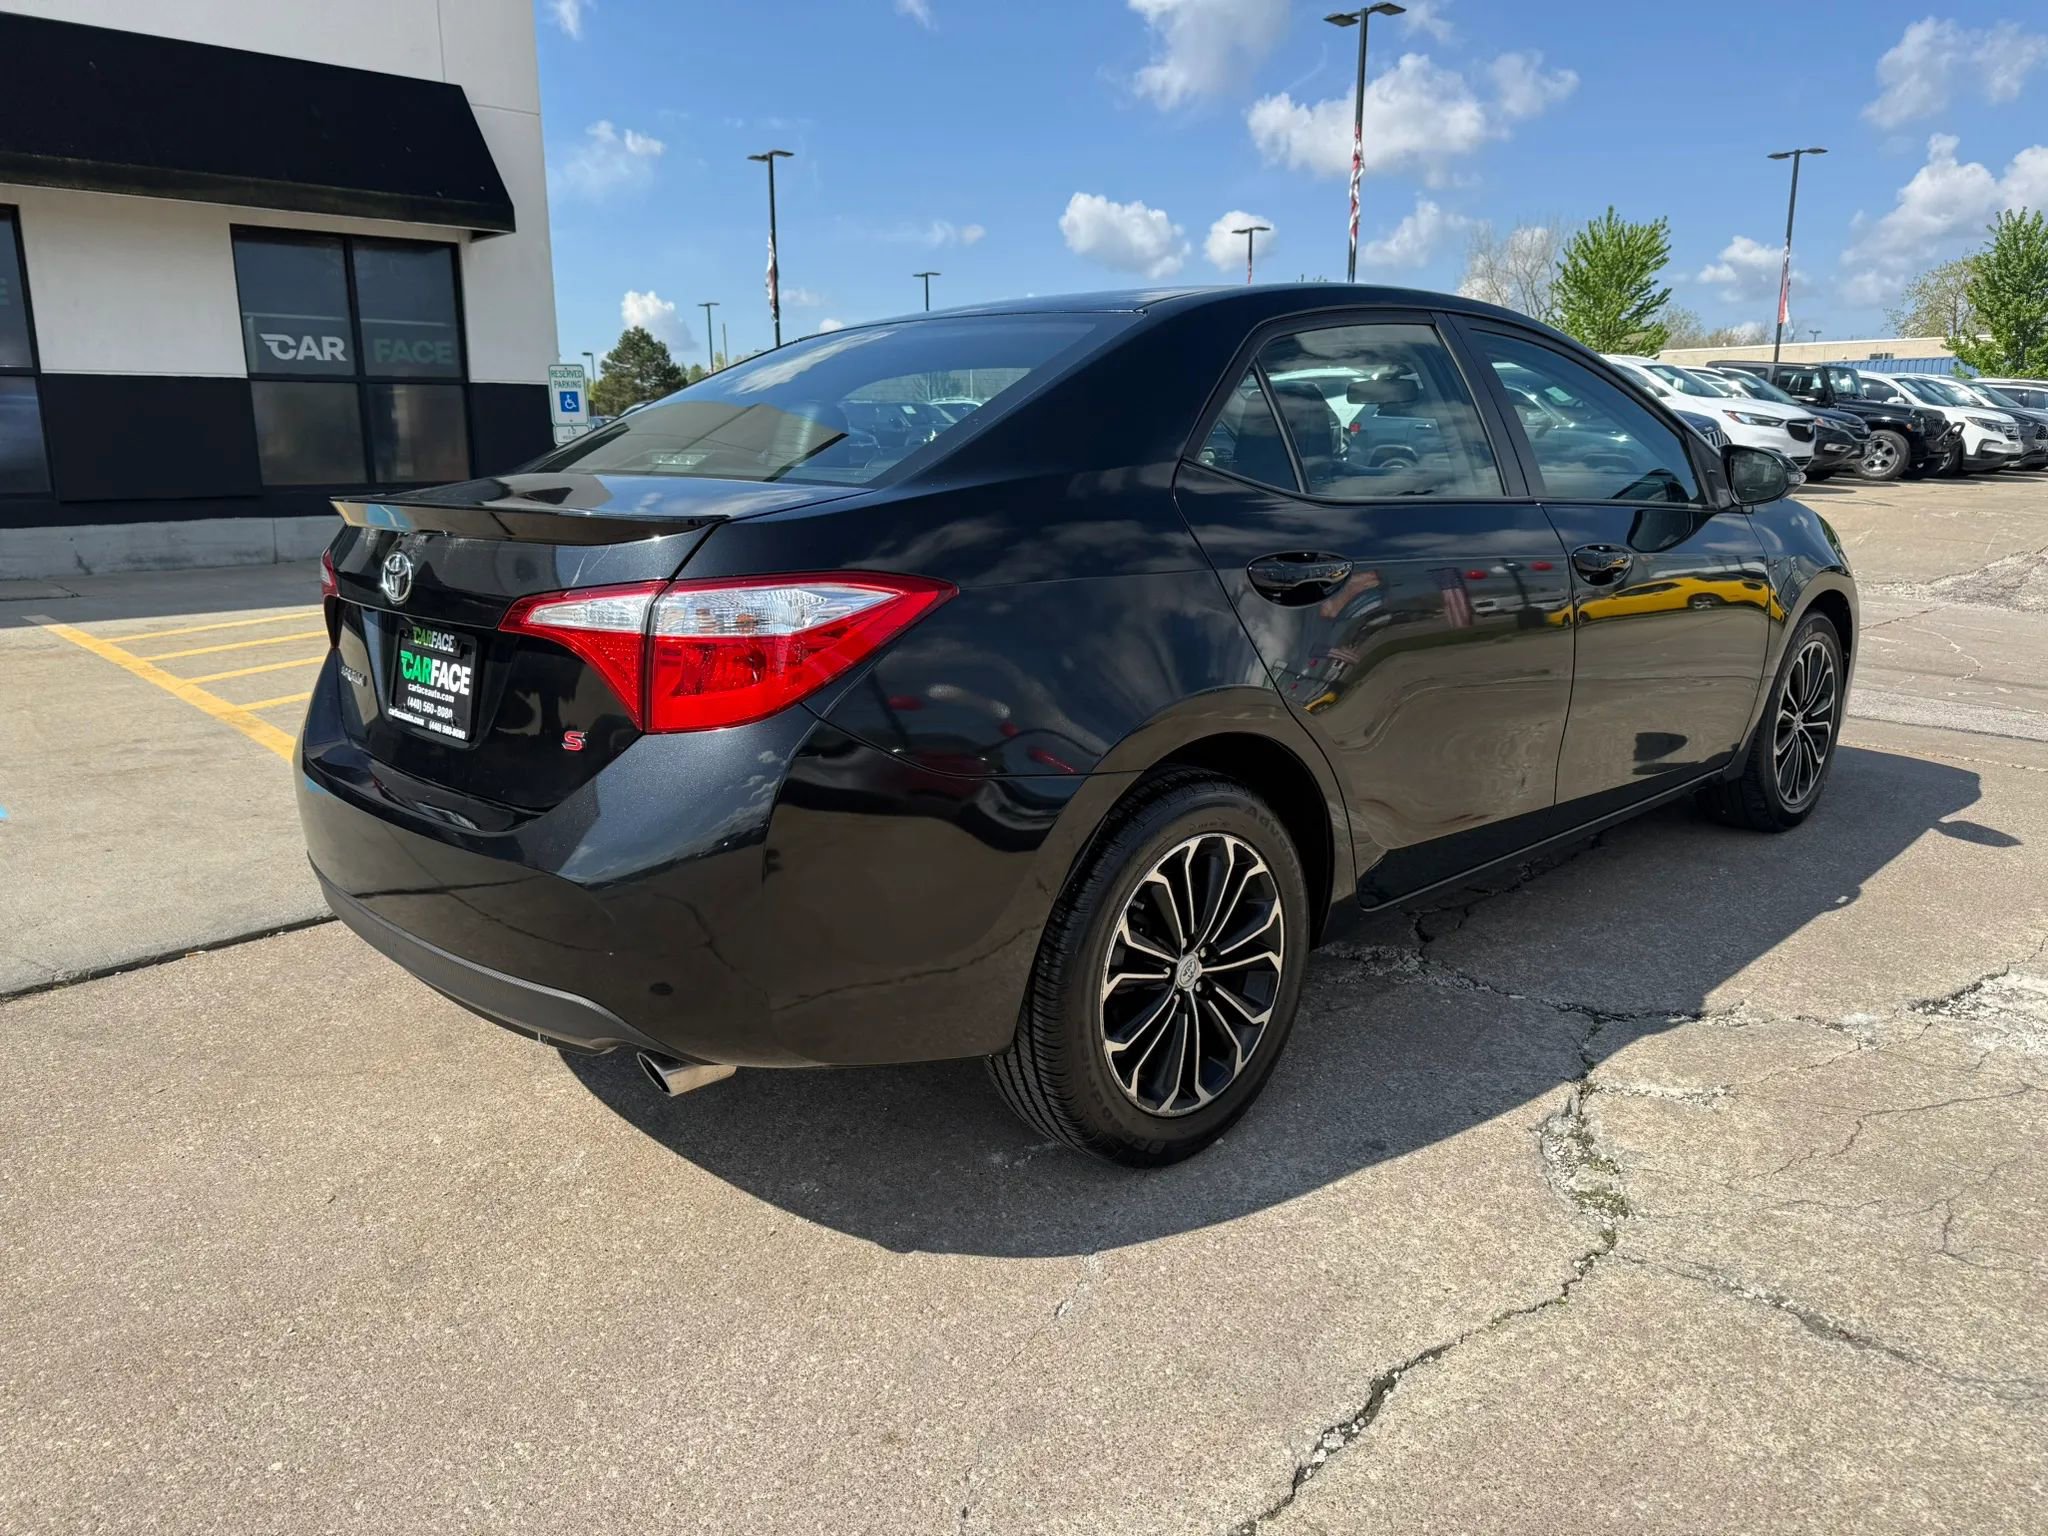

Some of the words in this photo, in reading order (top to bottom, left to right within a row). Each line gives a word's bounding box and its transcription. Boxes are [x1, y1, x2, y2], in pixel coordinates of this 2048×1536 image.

[259, 333, 348, 362] CAR
[374, 338, 455, 365] FACE
[551, 370, 583, 379] RESERVED
[554, 381, 582, 389] PARKING
[412, 626, 455, 652] CARFACE
[401, 649, 471, 696] CARFACE
[562, 730, 586, 752] S
